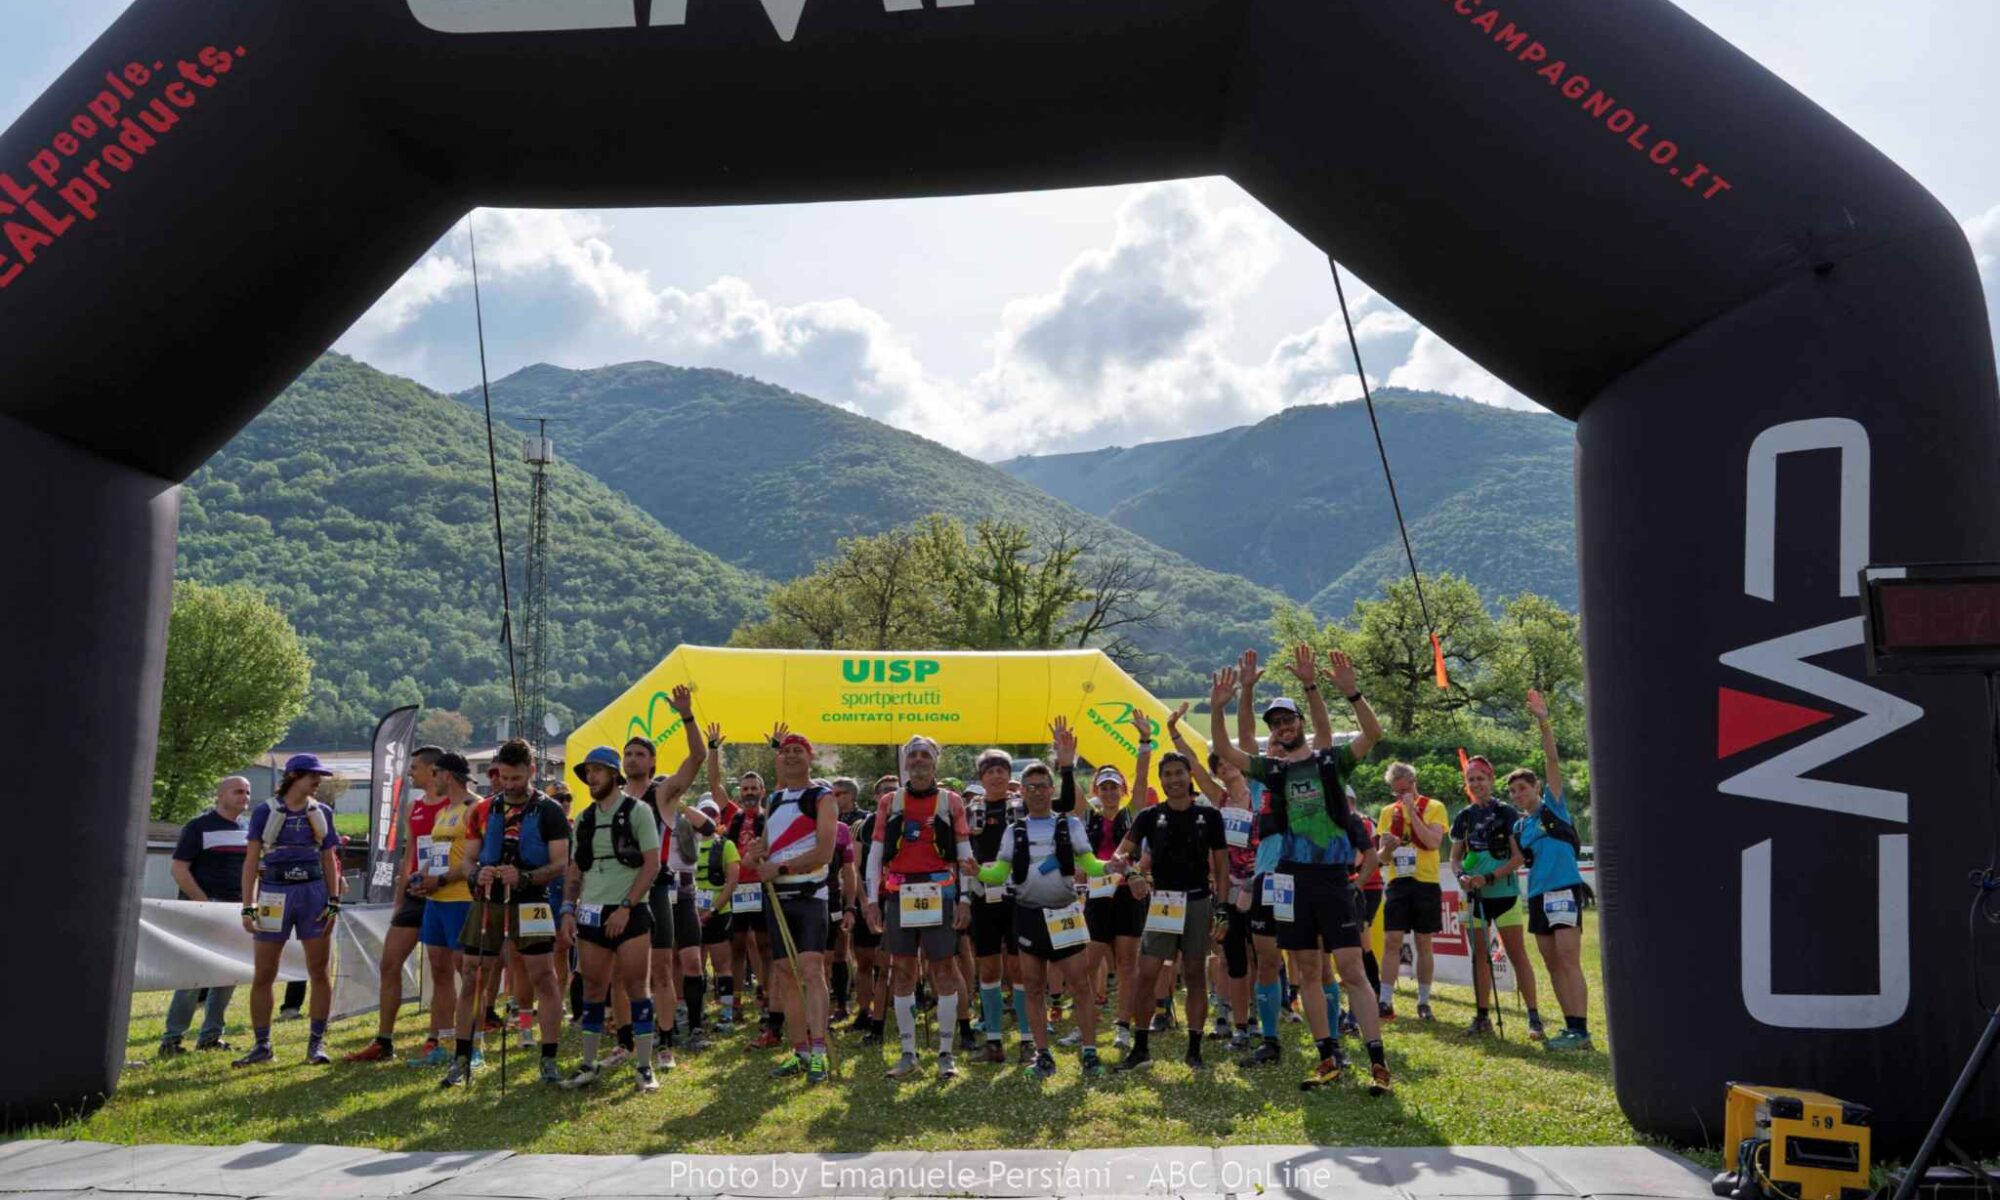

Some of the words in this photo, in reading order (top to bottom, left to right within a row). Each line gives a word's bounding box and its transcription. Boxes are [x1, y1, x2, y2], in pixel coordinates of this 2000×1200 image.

[842, 659, 940, 683] UISP
[841, 689, 941, 708] sportpertutti
[821, 713, 893, 722] COMITATO
[898, 713, 960, 722] FOLIGNO
[1717, 416, 1925, 1030] CMP
[1061, 917, 1075, 930] 29
